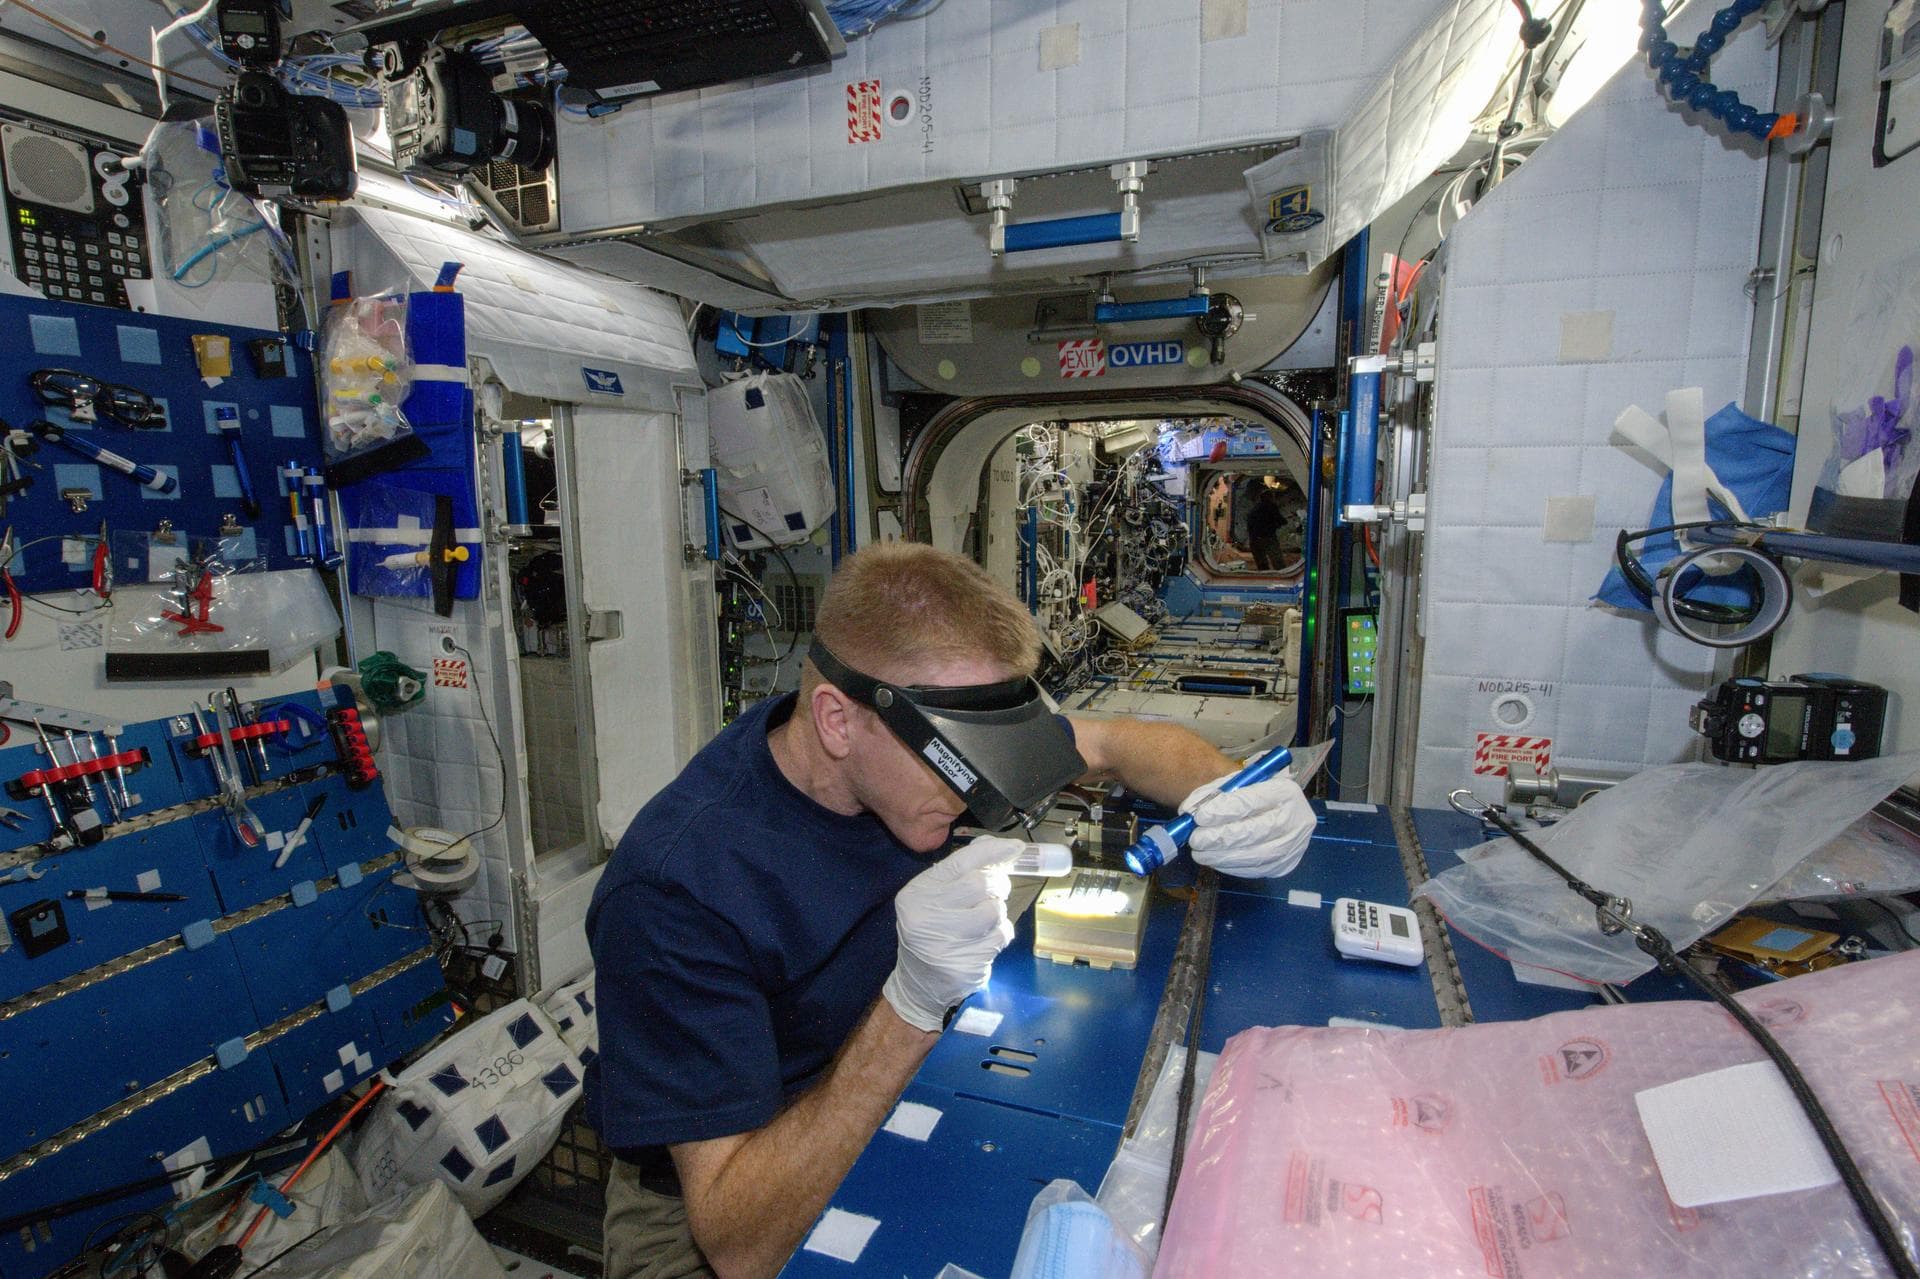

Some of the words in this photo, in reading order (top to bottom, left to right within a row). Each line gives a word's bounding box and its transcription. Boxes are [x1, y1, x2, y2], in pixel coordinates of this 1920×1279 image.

[1065, 349, 1097, 369] EXIT
[1111, 343, 1182, 366] OVHD
[931, 740, 975, 785] Magnifying
[937, 757, 959, 778] Visor
[1491, 753, 1509, 761] FIRE
[1511, 755, 1534, 763] PORT
[471, 1049, 525, 1091] 4386
